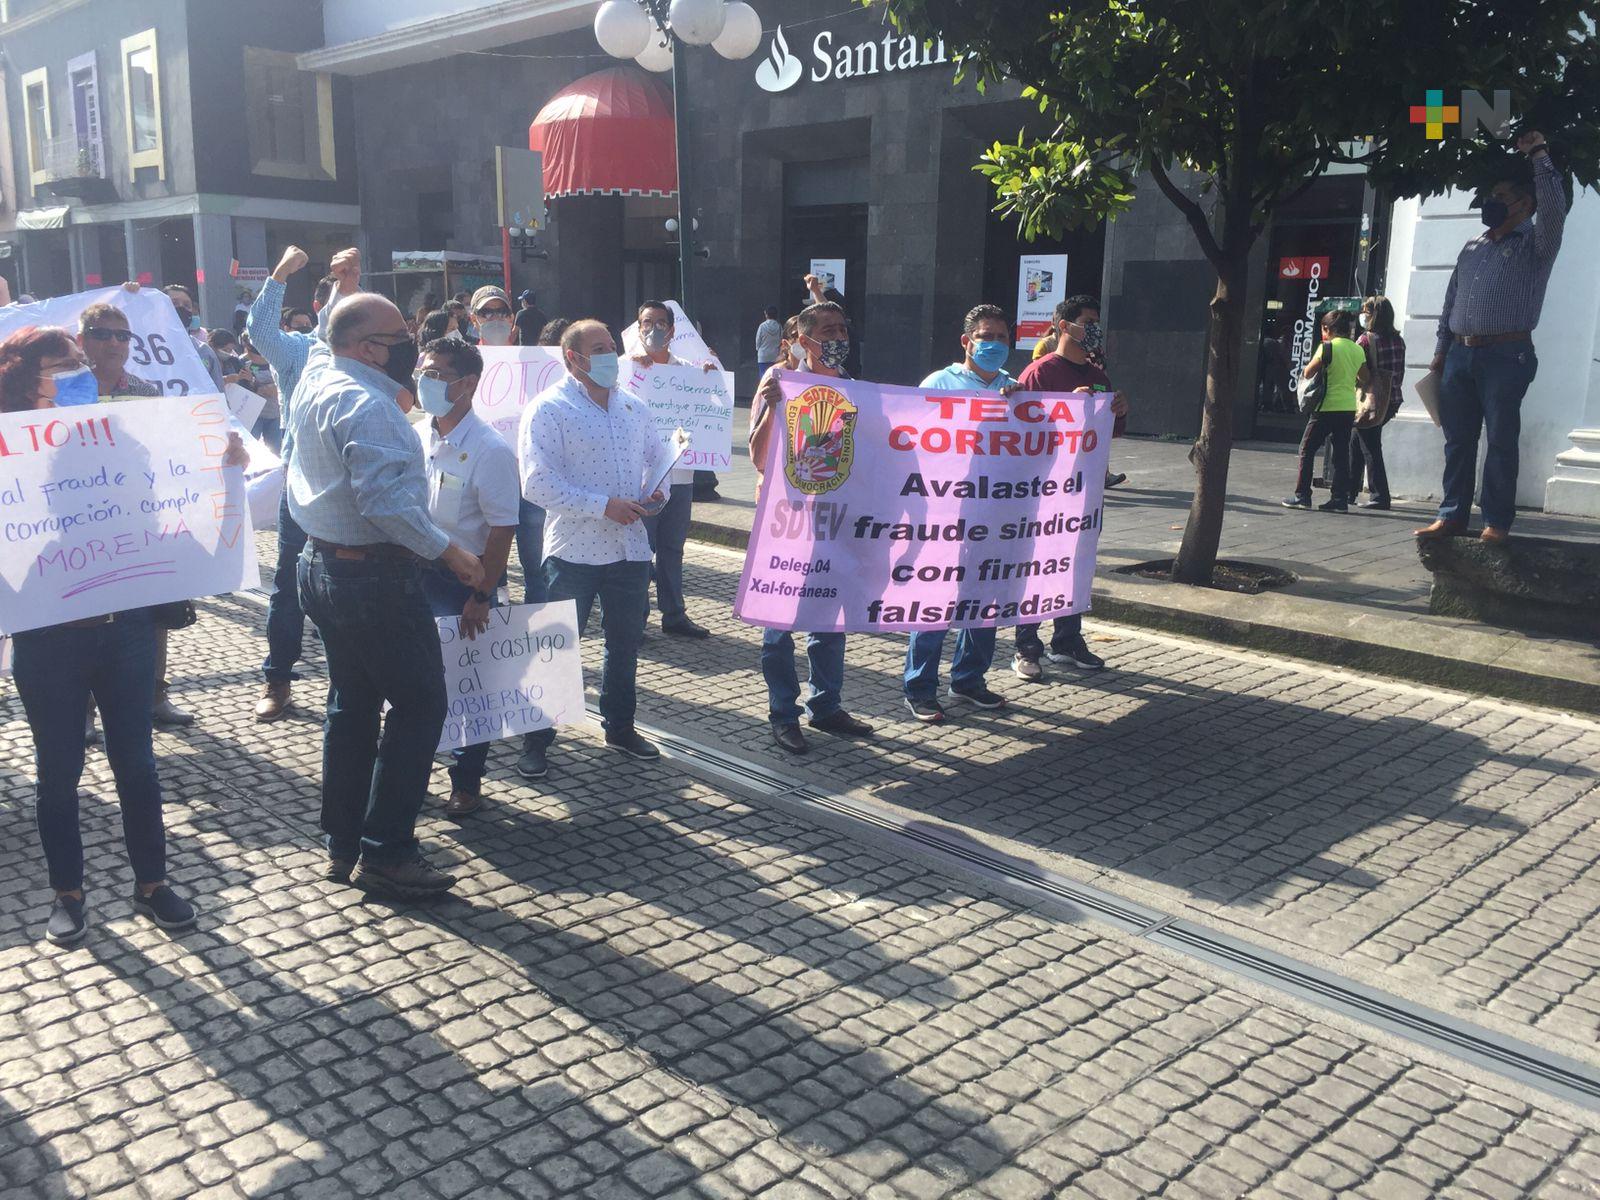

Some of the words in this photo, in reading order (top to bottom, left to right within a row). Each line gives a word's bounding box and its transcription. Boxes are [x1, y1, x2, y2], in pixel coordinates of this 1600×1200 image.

[811, 30, 966, 83] Santan
[1300, 262, 1321, 368] TOMATICO
[1288, 319, 1304, 392] CAJERO
[802, 387, 844, 406] SDTEV
[925, 395, 1075, 423] TECA
[0, 417, 116, 457] LTO!!!
[841, 412, 854, 463] SINDICAL
[888, 425, 1098, 456] CORRUPTO
[2, 478, 25, 506] al
[169, 459, 190, 477] la
[899, 472, 1058, 499] Avalaste
[1063, 471, 1082, 493] el
[770, 498, 848, 541] SDTEV
[853, 515, 989, 542] fraude
[999, 508, 1098, 540] sindical
[37, 516, 193, 577] MORENA
[769, 555, 830, 576] Deleg.04
[891, 563, 966, 583] con
[977, 555, 1071, 582] firmas
[749, 577, 838, 598] Xal-foráneas
[866, 593, 1073, 624] falsificadas.
[458, 647, 481, 668] de
[490, 631, 565, 663] castigo
[458, 668, 482, 694] al
